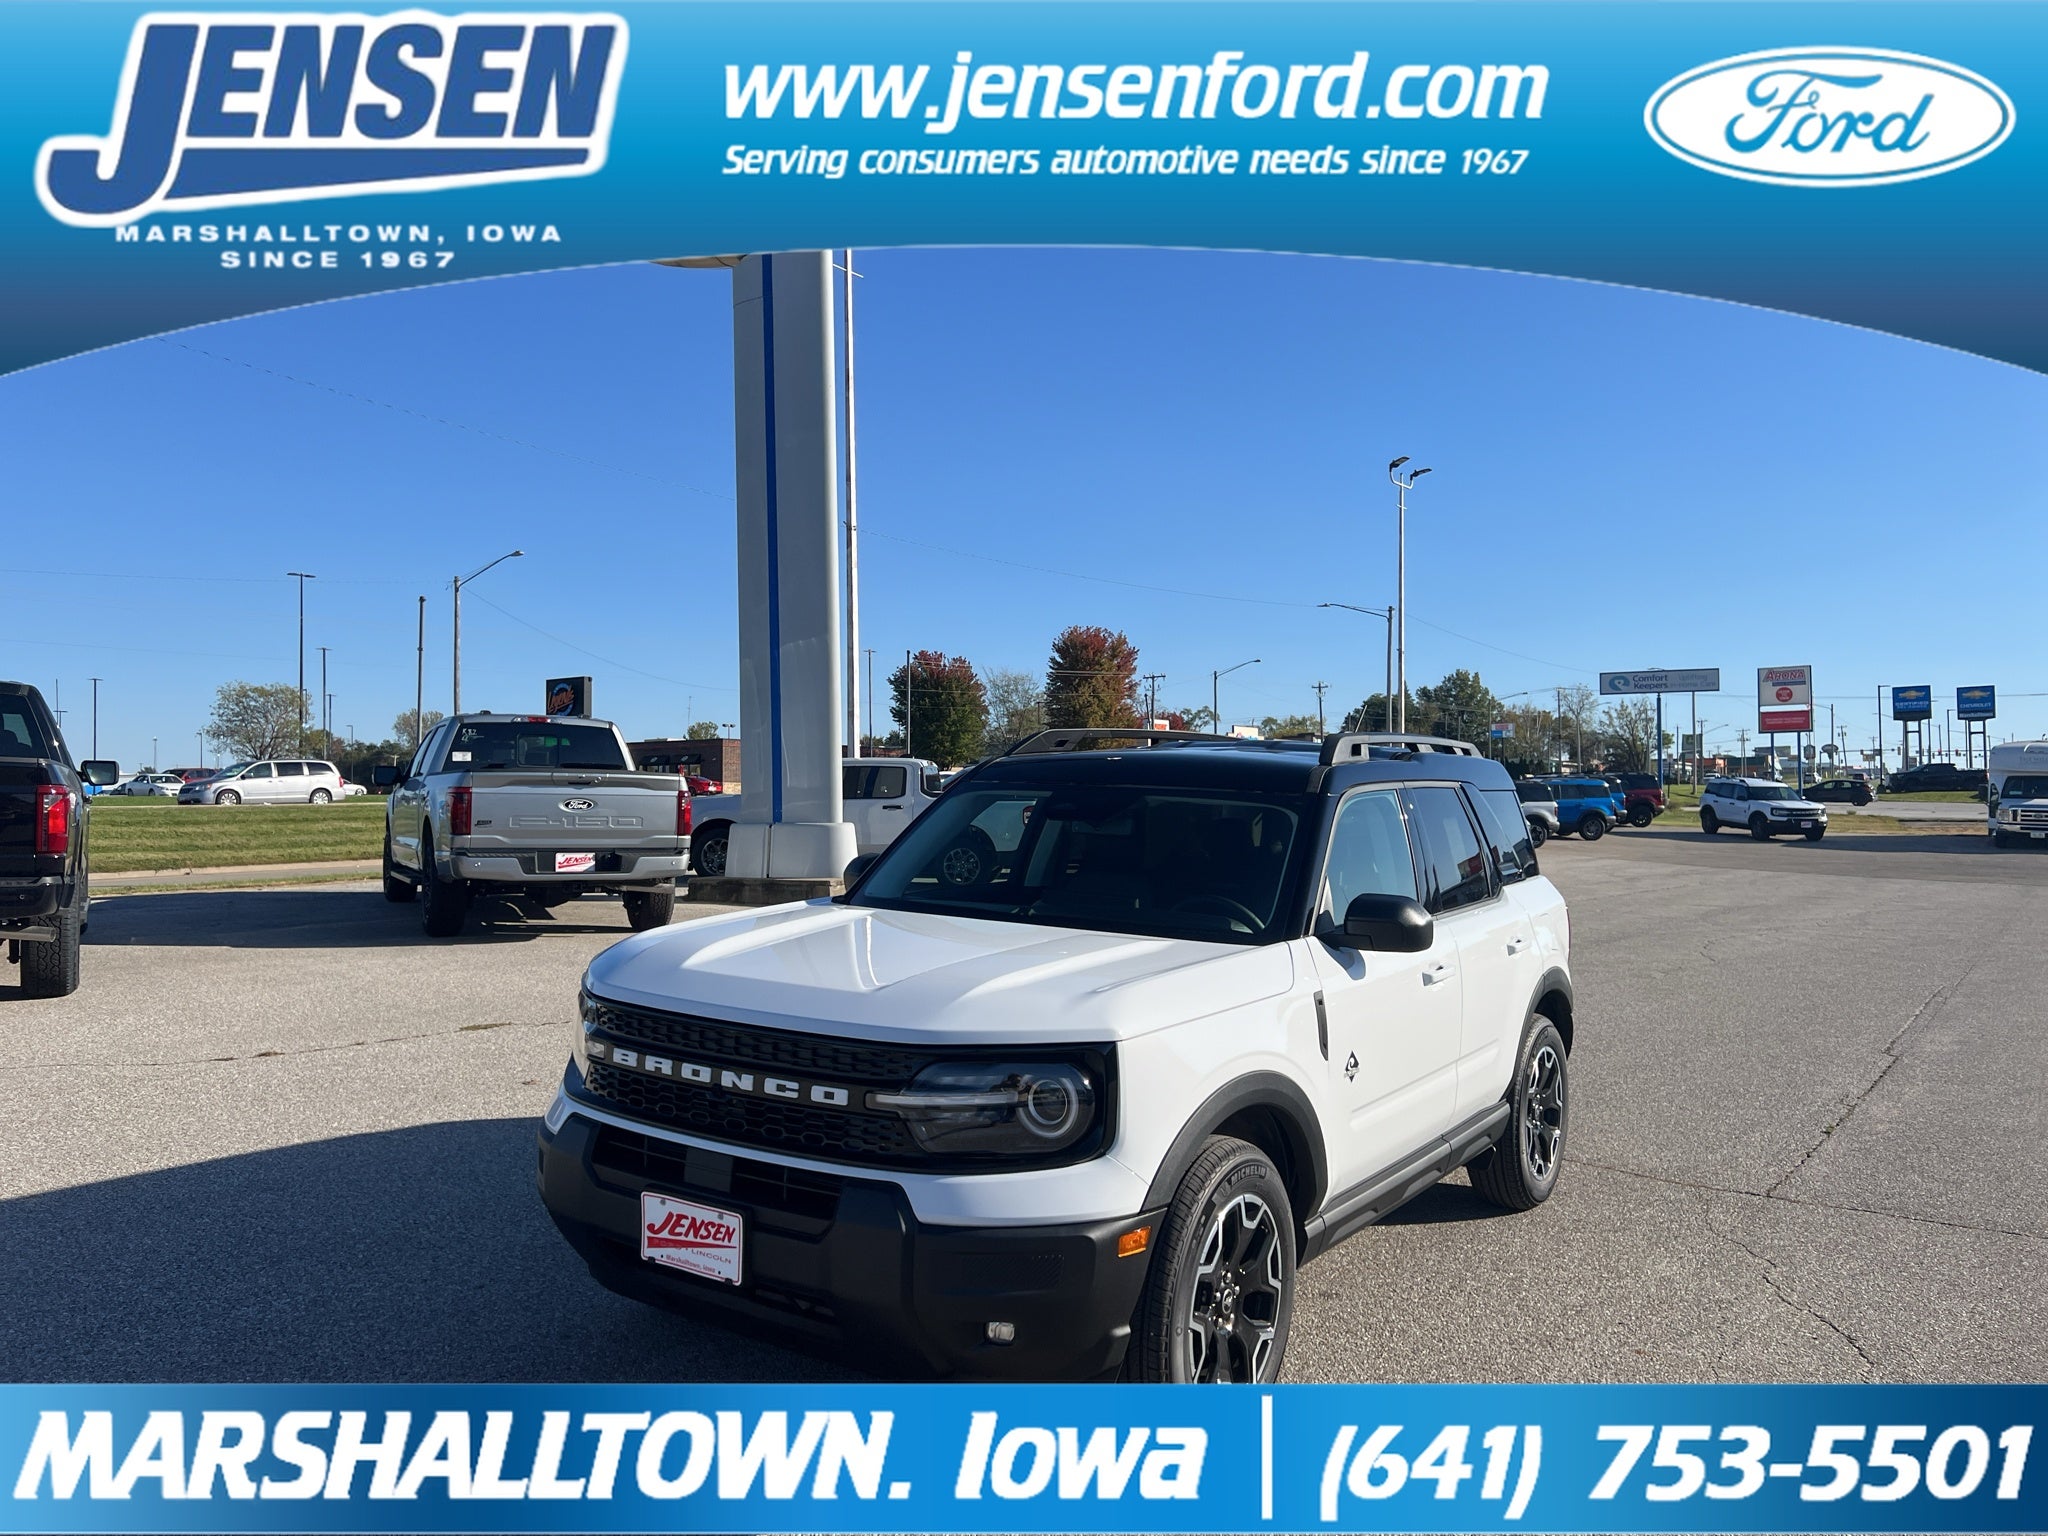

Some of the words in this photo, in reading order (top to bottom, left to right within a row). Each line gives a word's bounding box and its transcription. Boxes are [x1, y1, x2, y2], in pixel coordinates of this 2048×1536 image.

[1632, 674, 1668, 683] Comfort
[1633, 681, 1669, 690] Keepers
[567, 799, 590, 810] Ford
[509, 815, 644, 829] F-150
[557, 856, 595, 866] JENSEN
[612, 1047, 849, 1107] BRONCO
[1230, 1164, 1267, 1187] MICHELIN
[646, 1211, 736, 1243] JENSEN
[691, 1248, 732, 1264] LINCOLN
